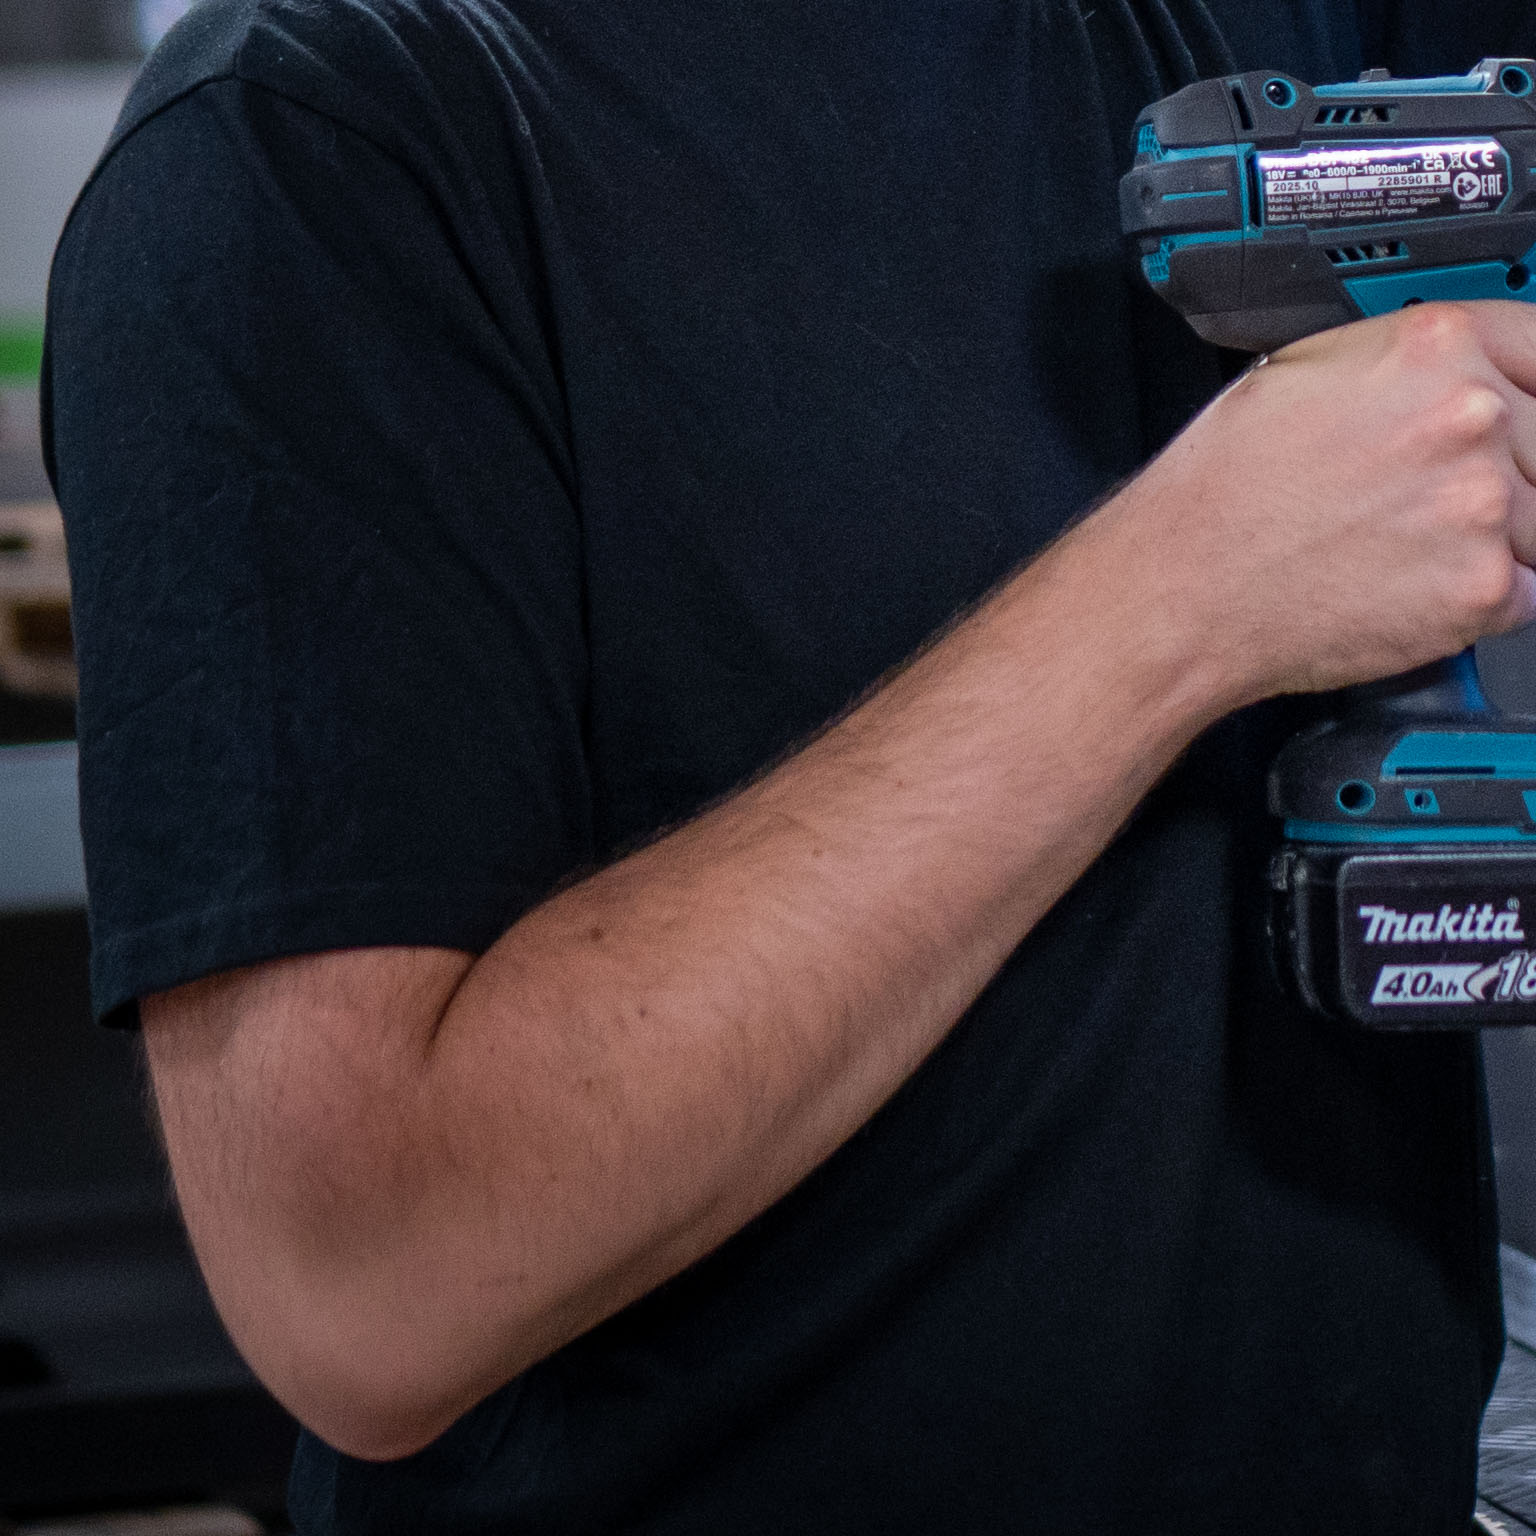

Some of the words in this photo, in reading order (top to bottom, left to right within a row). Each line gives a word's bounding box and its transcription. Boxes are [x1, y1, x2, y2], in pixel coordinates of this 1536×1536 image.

[1378, 175, 1429, 186] 2285901
[1434, 175, 1442, 183] R
[1273, 181, 1319, 192] 2025.10
[1382, 971, 1459, 998] 4.0Ah
